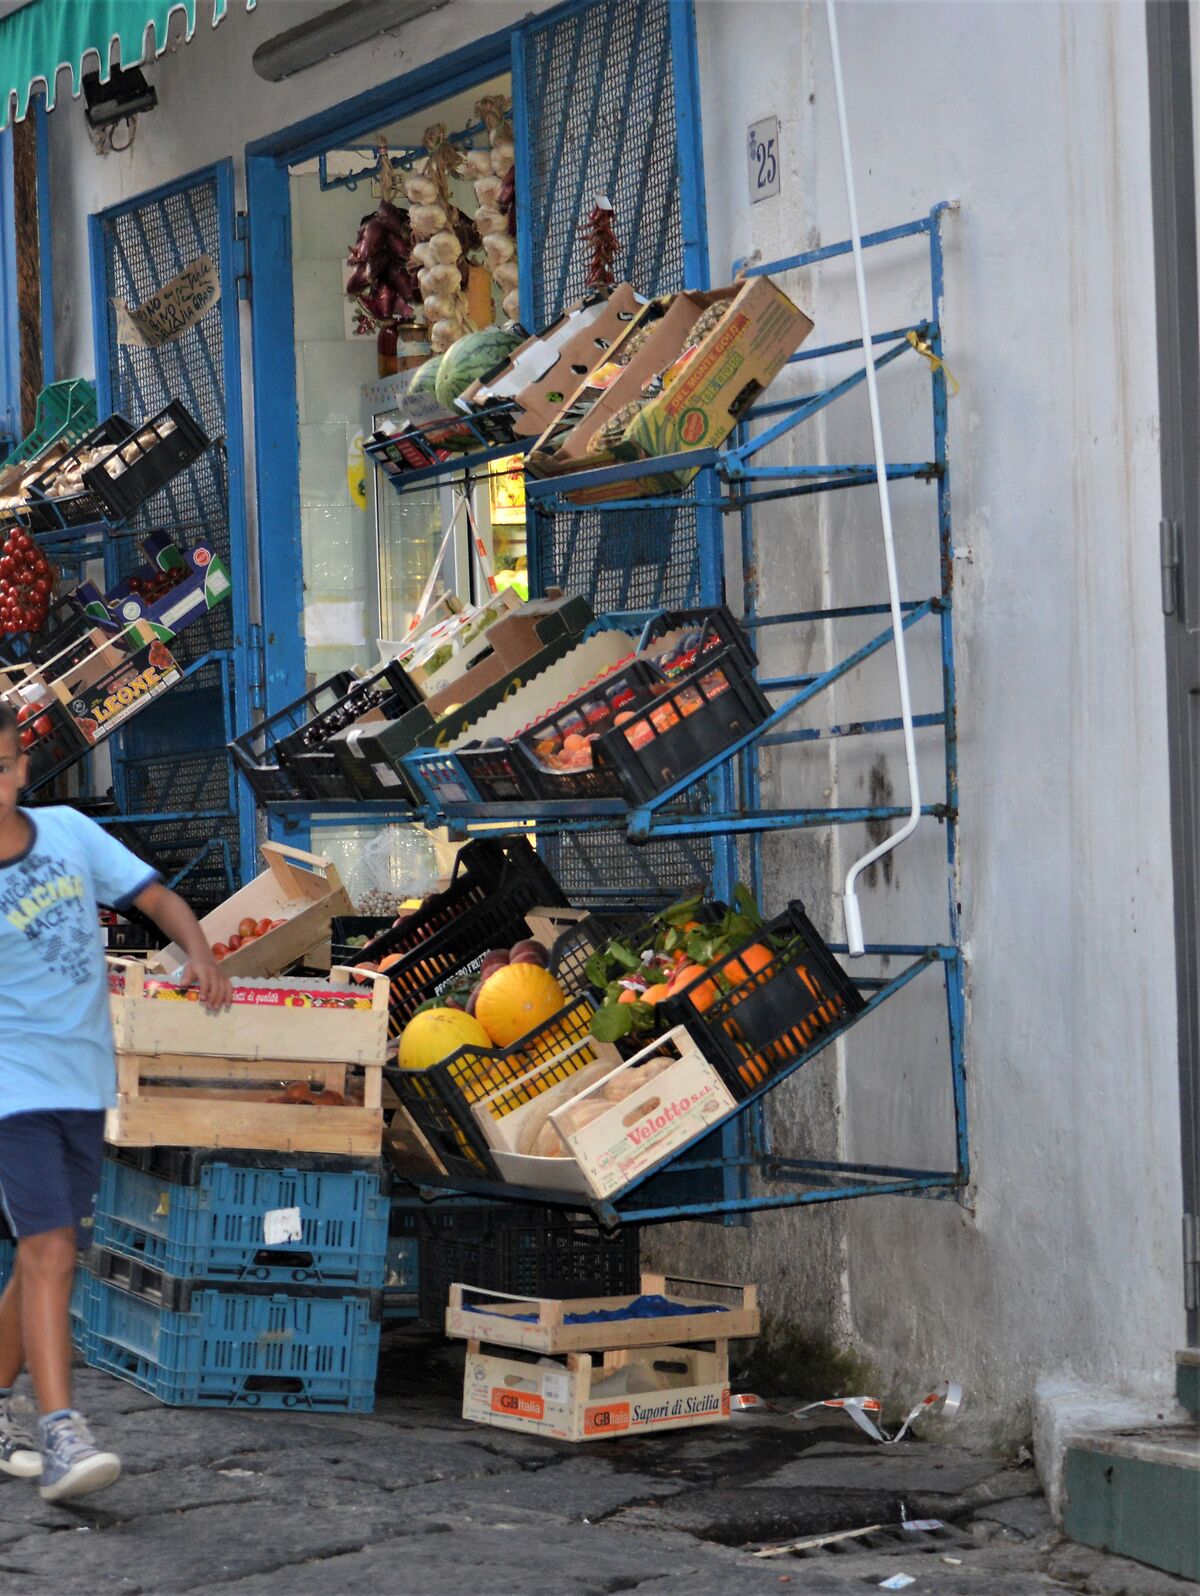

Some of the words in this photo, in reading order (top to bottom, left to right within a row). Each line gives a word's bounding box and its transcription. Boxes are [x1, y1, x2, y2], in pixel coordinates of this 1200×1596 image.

[757, 139, 776, 188] 25
[670, 386, 690, 408] DEL
[685, 351, 718, 388] MONTE
[713, 323, 740, 353] GOLD
[91, 666, 161, 723] LEONE
[627, 1097, 691, 1146] Velotto
[632, 1401, 669, 1424] Sapori
[671, 1399, 683, 1416] di
[685, 1394, 720, 1414] Sicilia
